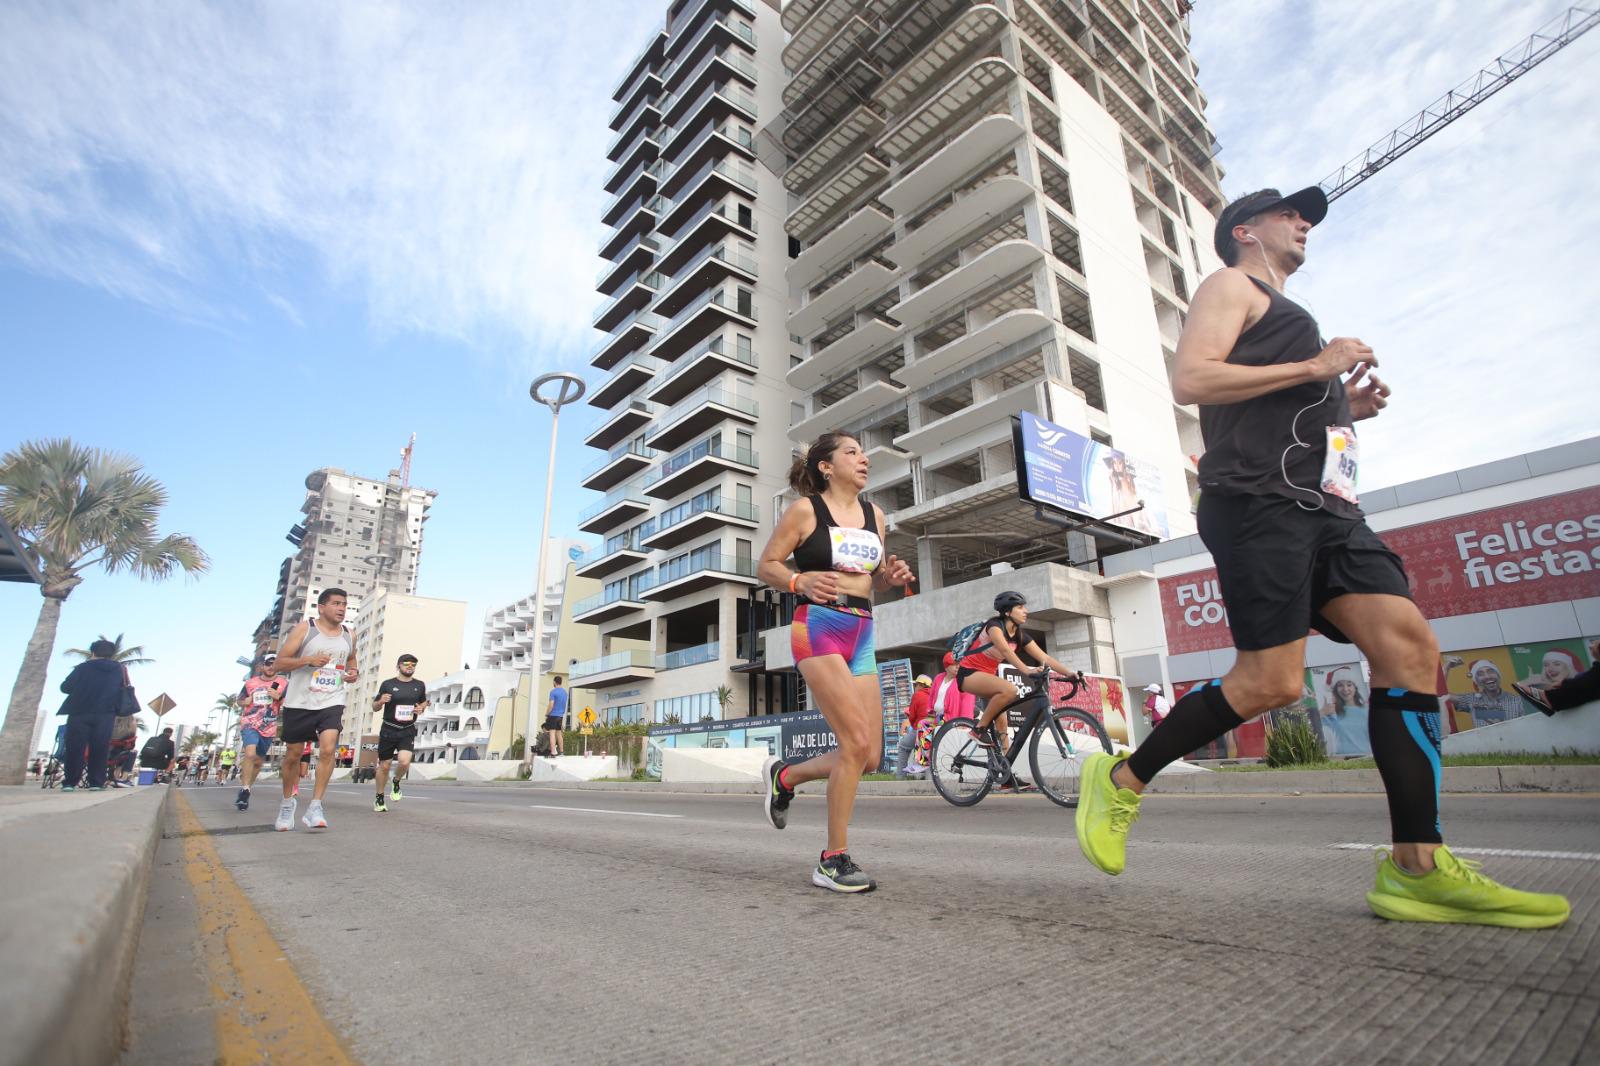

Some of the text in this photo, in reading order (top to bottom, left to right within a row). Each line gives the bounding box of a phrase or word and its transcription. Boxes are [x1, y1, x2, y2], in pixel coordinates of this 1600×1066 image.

[1455, 514, 1600, 560] Felices
[838, 542, 878, 560] 4259
[315, 677, 336, 685] 1034
[792, 734, 806, 748] HAZ
[807, 733, 816, 747] DE
[817, 732, 827, 747] LO
